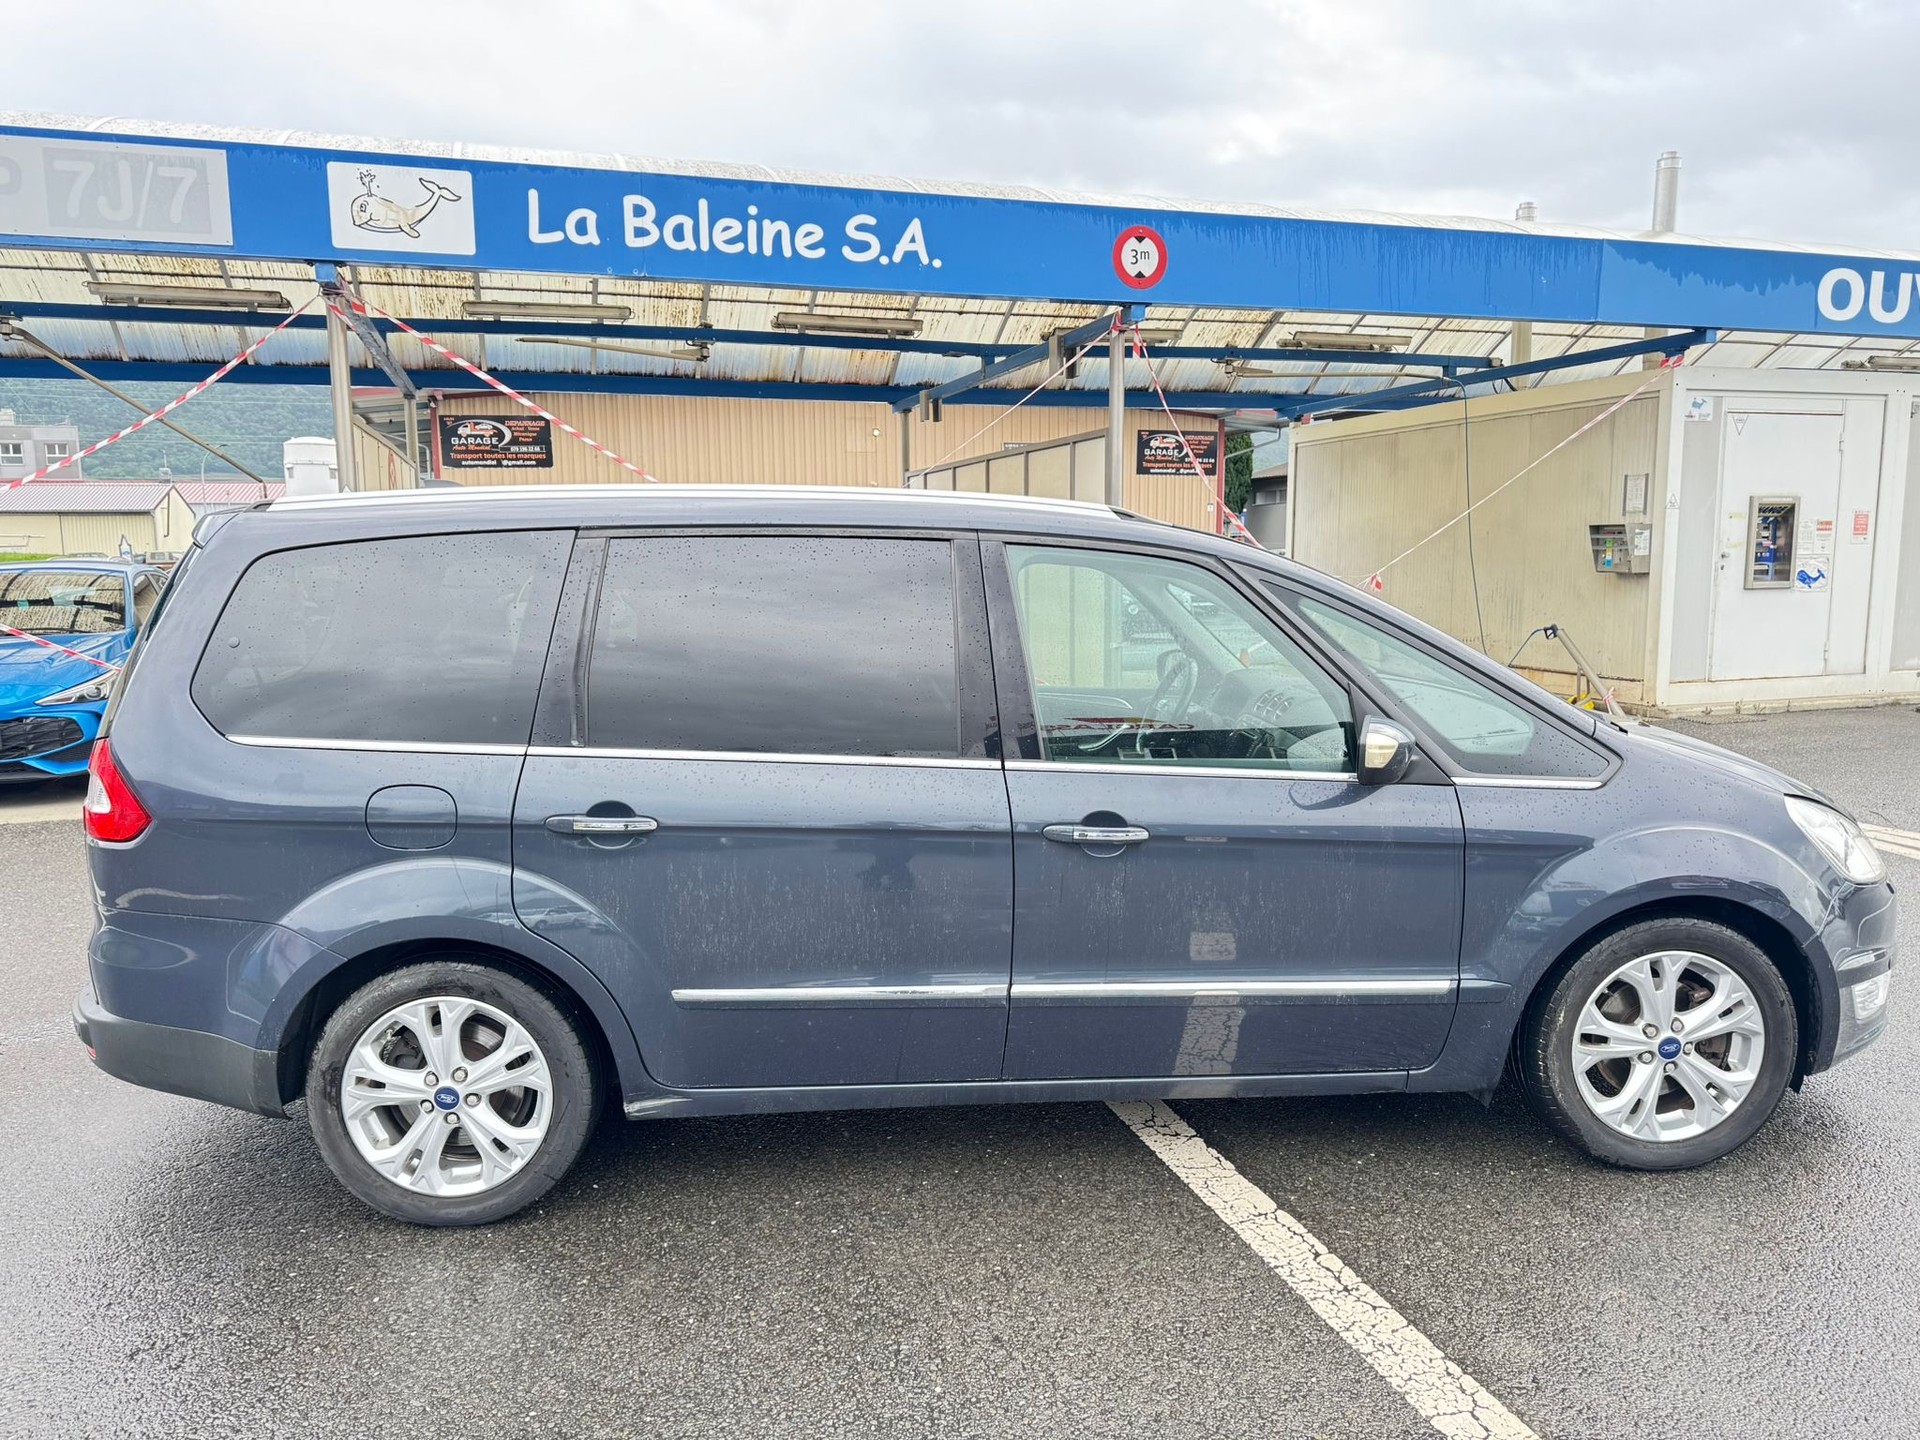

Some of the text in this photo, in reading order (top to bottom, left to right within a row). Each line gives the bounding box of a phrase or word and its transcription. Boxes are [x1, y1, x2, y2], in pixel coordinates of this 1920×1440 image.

[53, 160, 197, 228] 7J/7
[528, 188, 943, 269] La Baleine S.A.
[1816, 267, 1920, 324] OU
[450, 452, 482, 460] Transport
[484, 452, 505, 460] toutes
[507, 452, 517, 460] les
[451, 437, 499, 445] GARAGE
